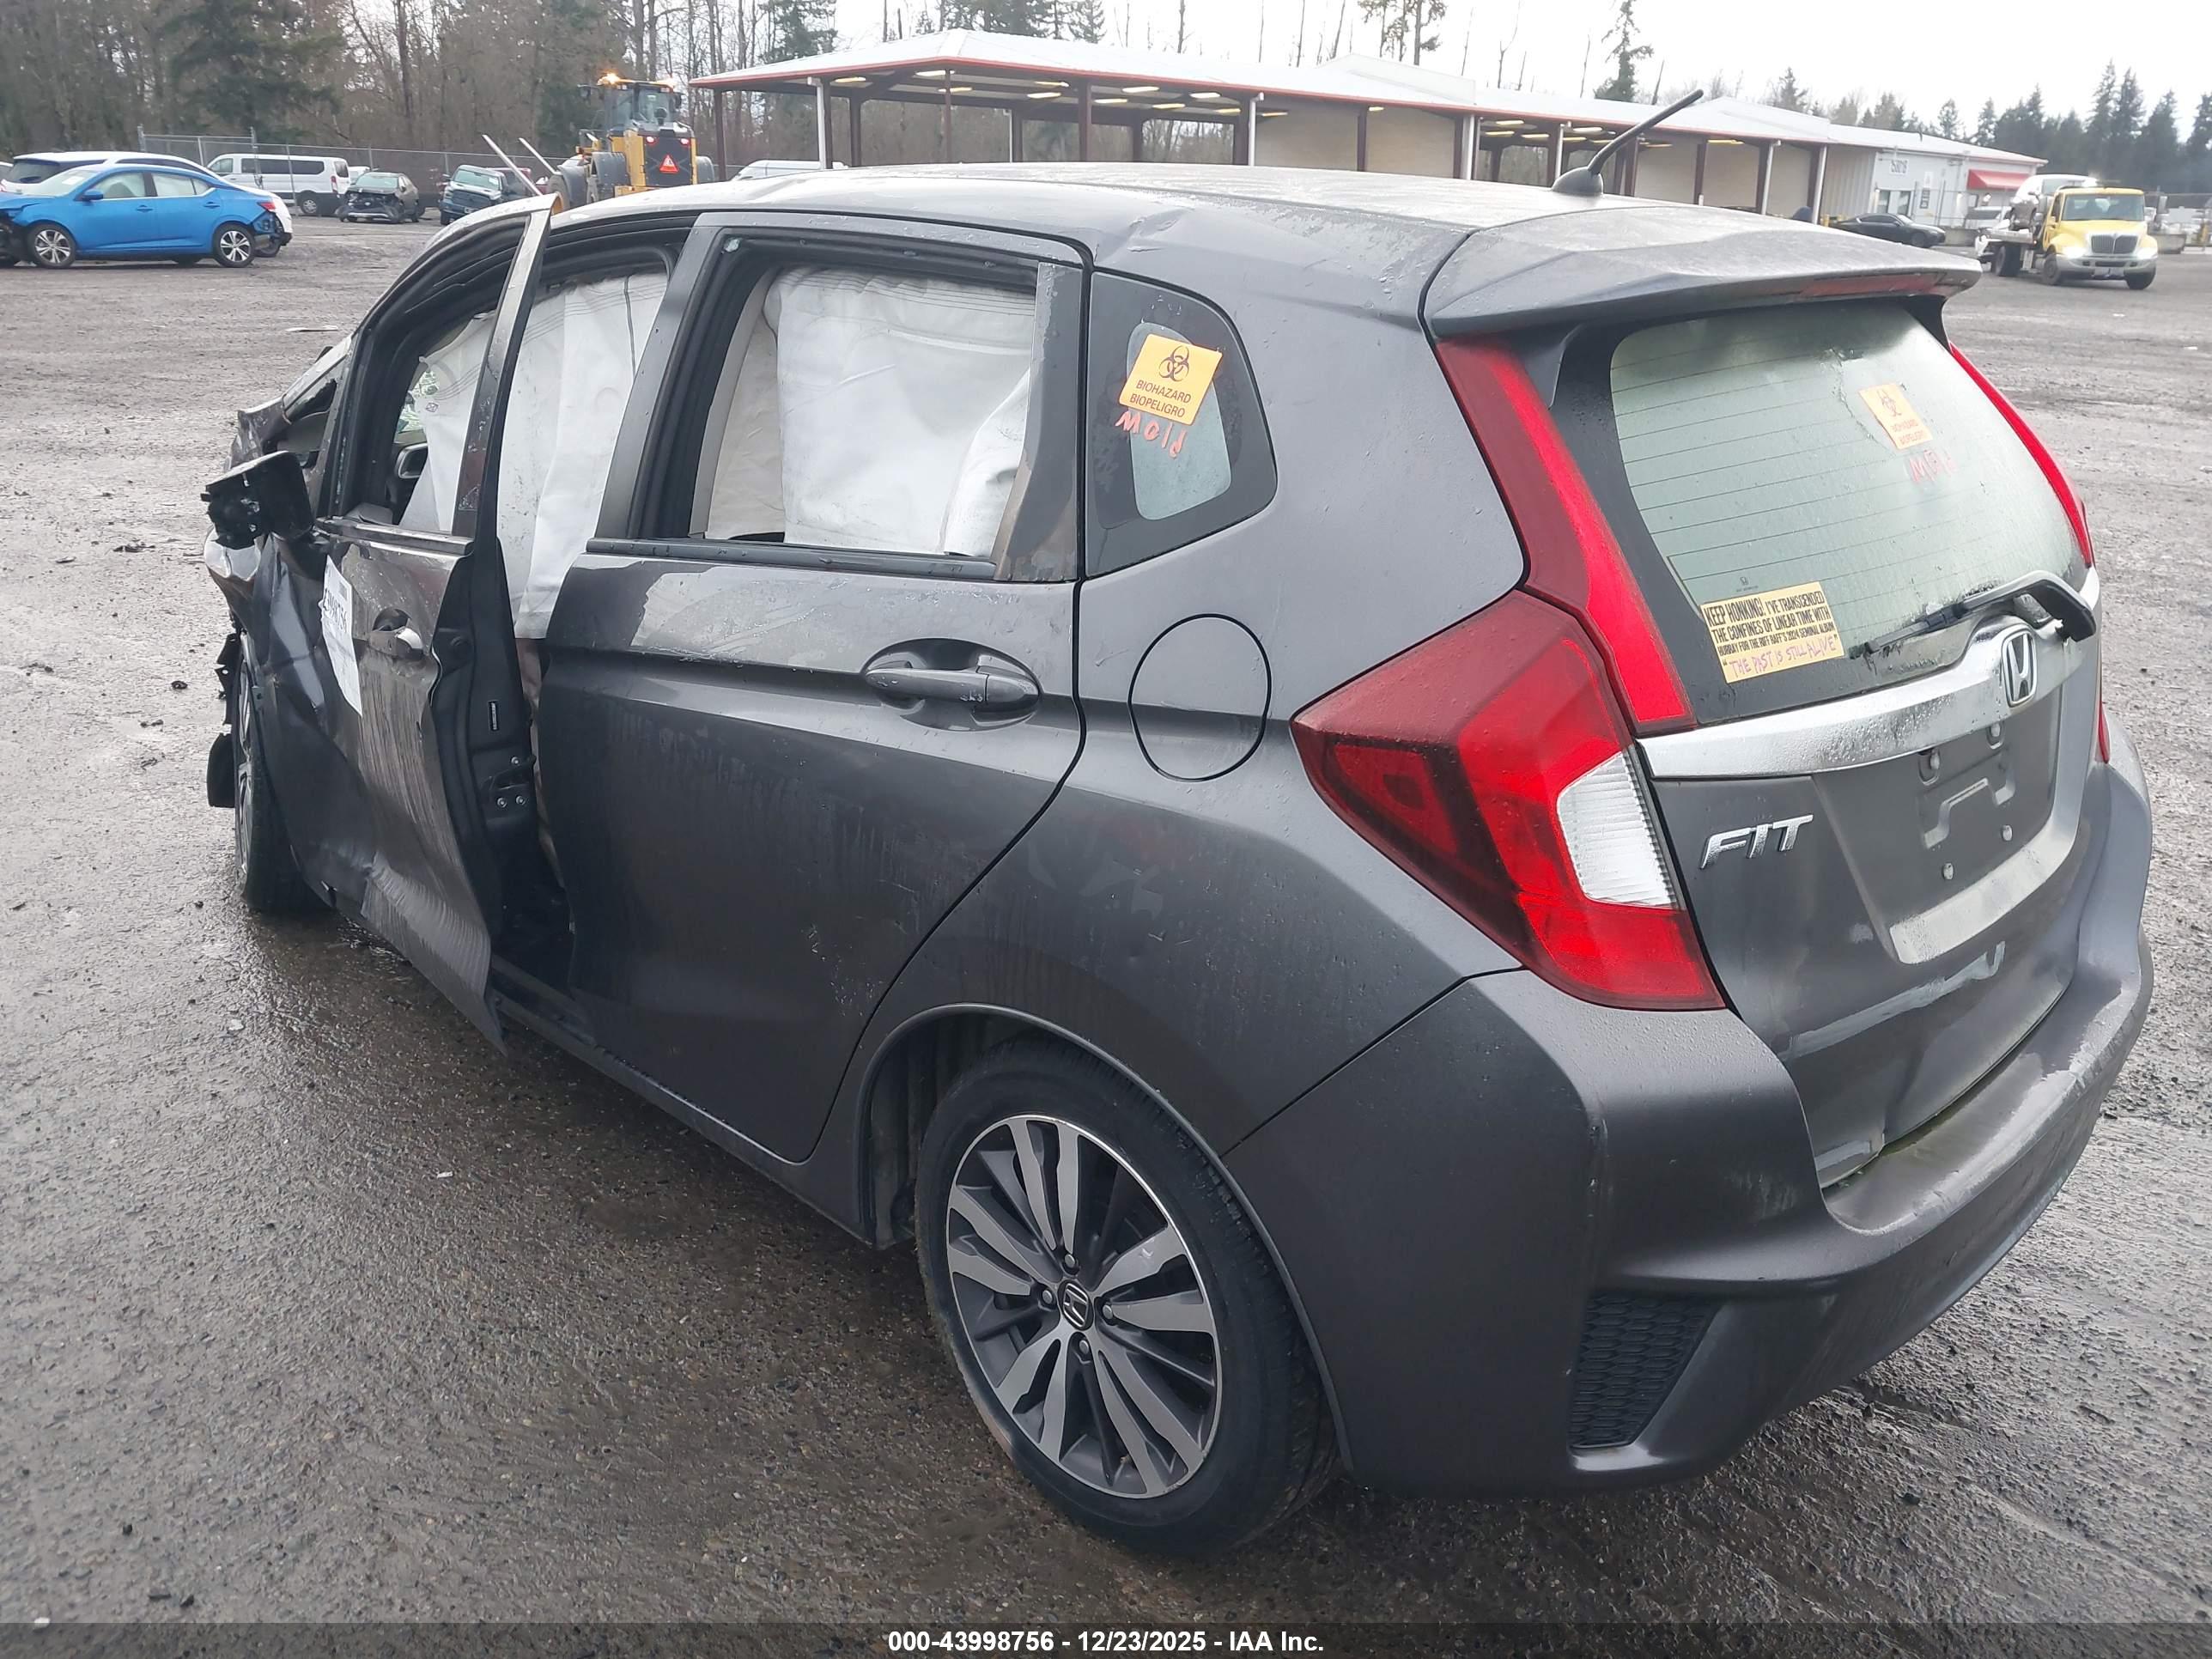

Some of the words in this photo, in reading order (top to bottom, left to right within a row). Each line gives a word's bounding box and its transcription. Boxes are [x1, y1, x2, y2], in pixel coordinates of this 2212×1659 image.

[1129, 393, 1185, 418] BIOPELIGRO
[1136, 380, 1191, 404] BIOHAZARD
[1704, 605, 1725, 627] KEEP
[1728, 598, 1765, 622] HONKING!
[1765, 600, 1781, 615] I'VE
[1780, 591, 1825, 611] TRANSCENDED
[1711, 628, 1729, 643] THE
[1729, 621, 1764, 640] CONFINES
[1763, 619, 1773, 631] OF
[1773, 613, 1796, 630] LINEAR
[1797, 611, 1814, 625] TIME
[1813, 606, 1831, 621] WITH
[1738, 641, 1750, 651] FOR
[1749, 639, 1759, 649] THE
[1787, 629, 1800, 641] 2024
[1752, 651, 1773, 673] PAST
[1777, 652, 1784, 665] IS
[1786, 645, 1807, 661] STILL
[1699, 814, 1814, 870] FIT
